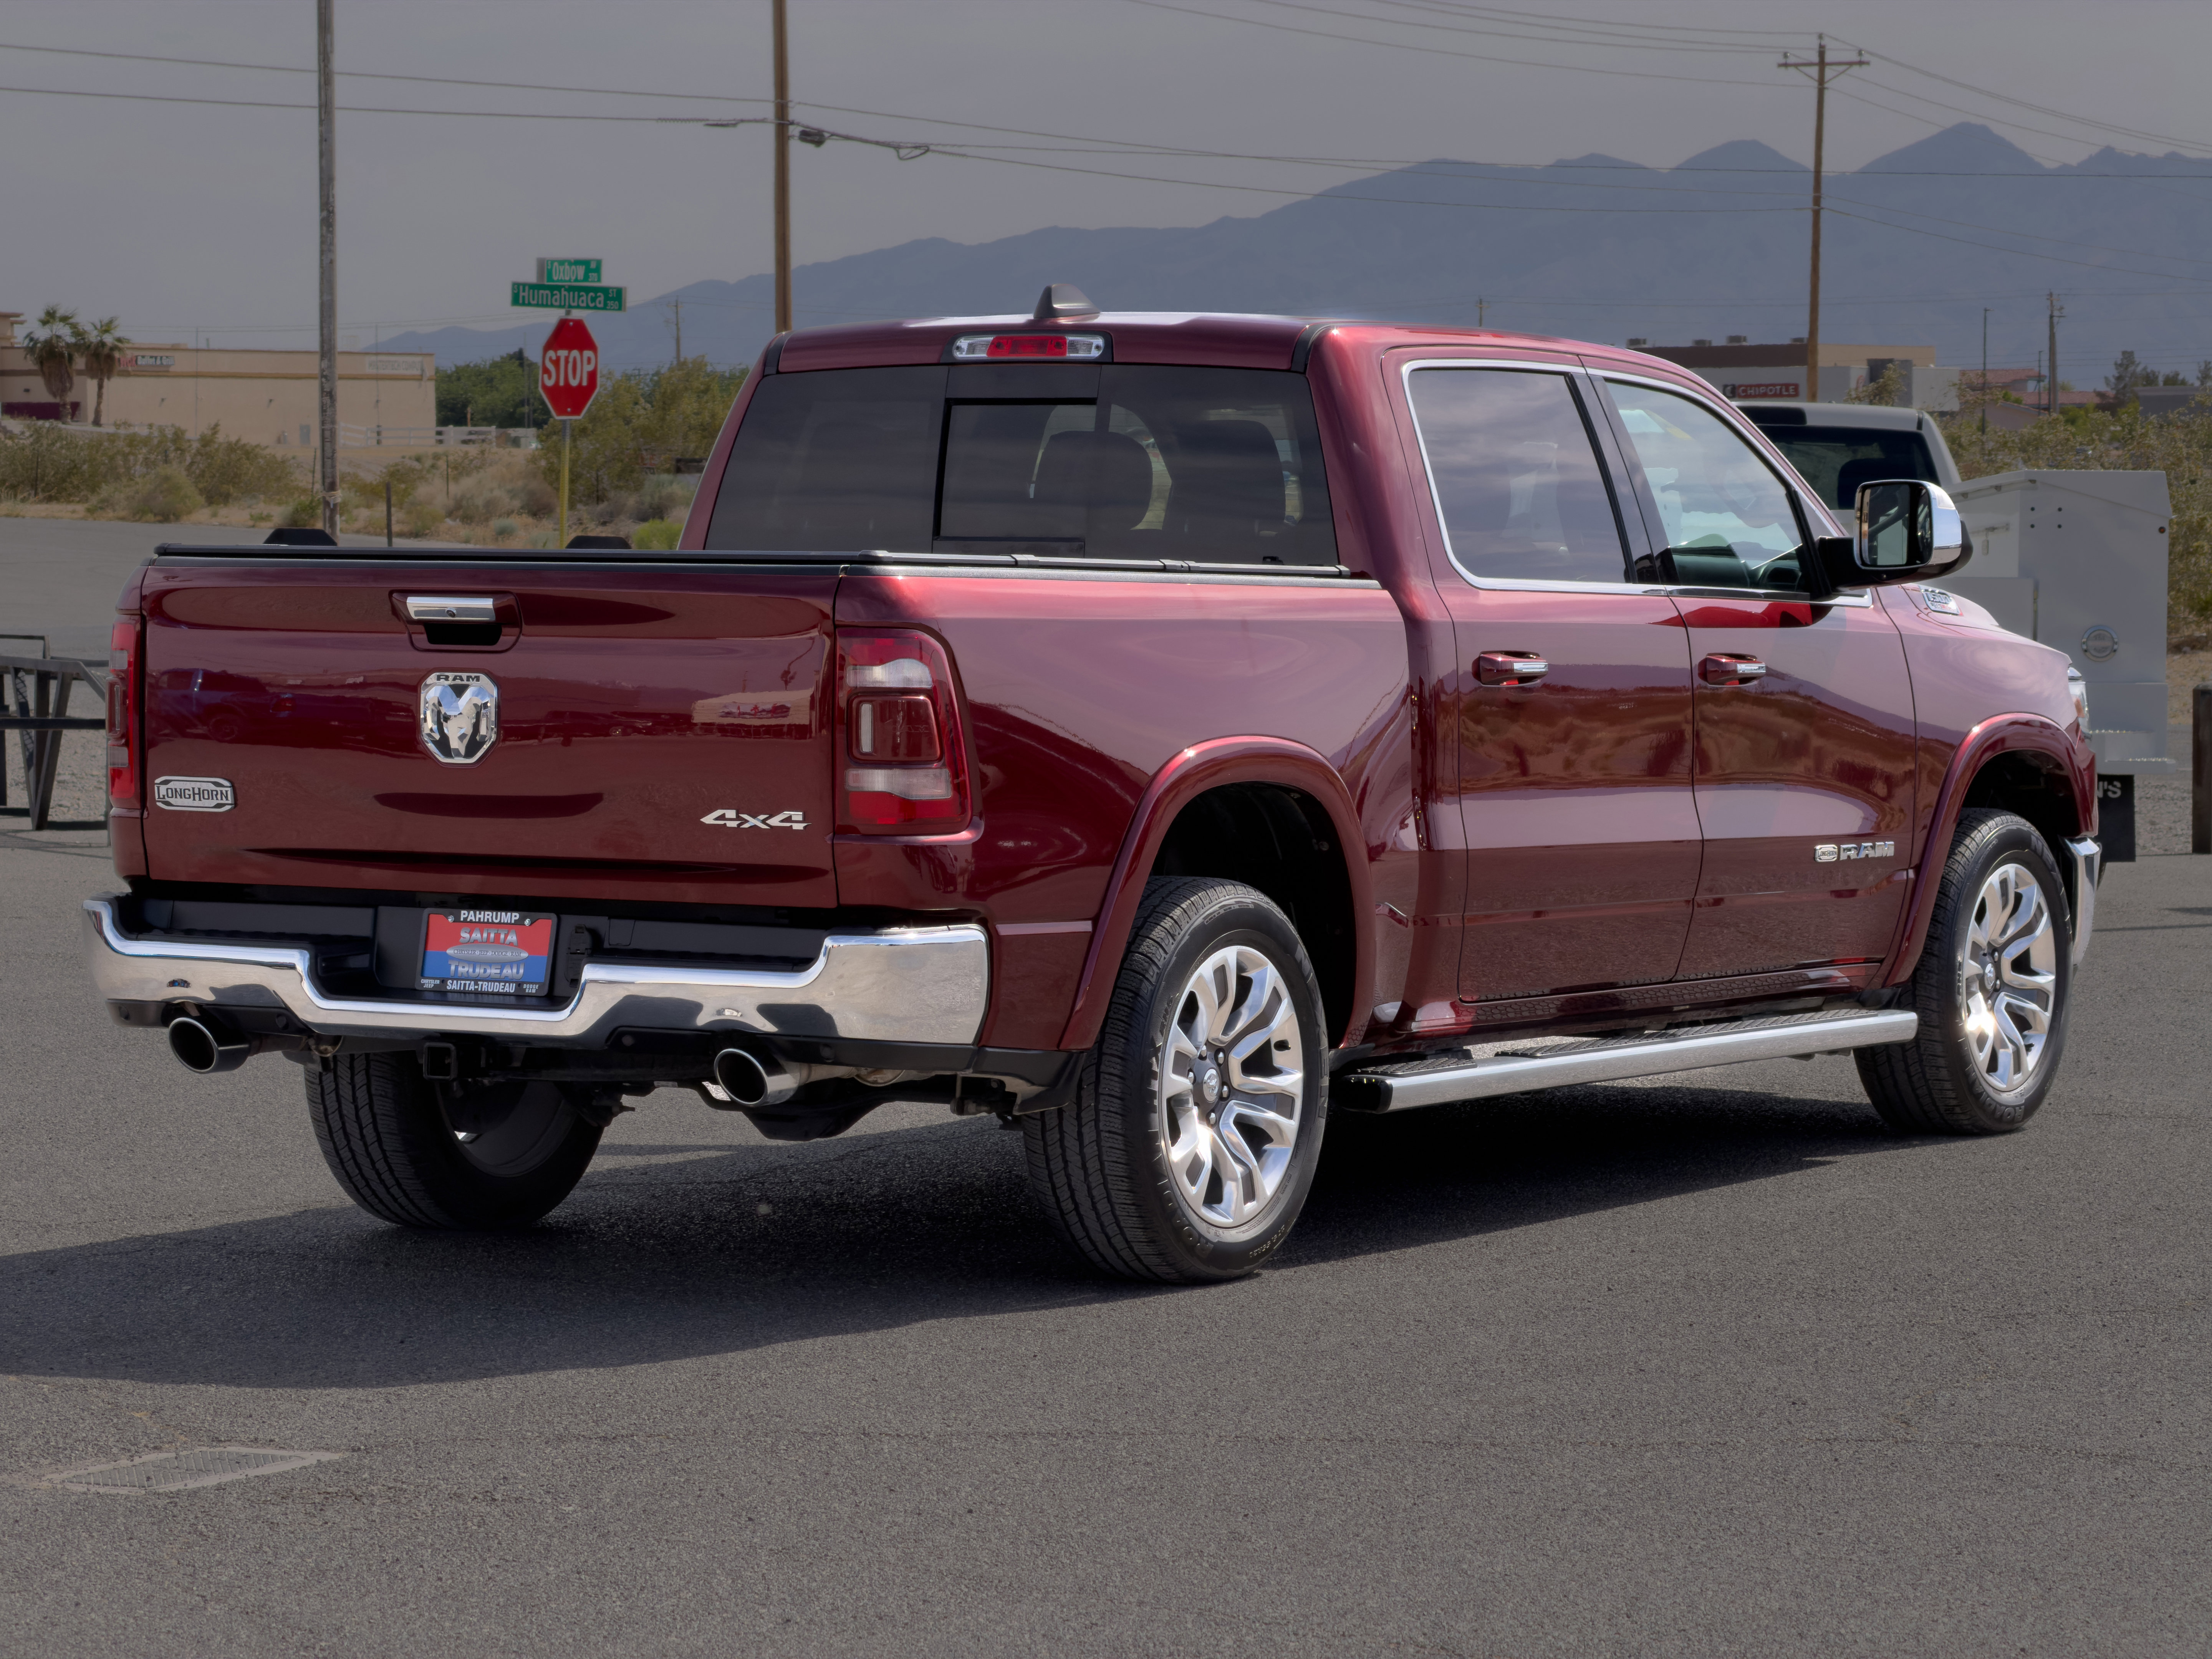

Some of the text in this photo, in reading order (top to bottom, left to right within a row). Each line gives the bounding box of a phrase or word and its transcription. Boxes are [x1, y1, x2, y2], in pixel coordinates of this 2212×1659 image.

[548, 261, 551, 269] S
[552, 262, 585, 280] Oxbow
[513, 285, 617, 308] S Humahuaca ST
[606, 301, 619, 309] 350
[543, 349, 595, 387] STOP
[1738, 386, 1796, 396] CHIPOTLE
[700, 809, 812, 830] 4x4
[1839, 841, 1894, 861] RAM
[460, 911, 520, 923] PAHRUMP
[459, 927, 518, 946] SAITTA
[448, 959, 525, 980] TRUDEAU
[447, 980, 516, 993] SAITTA-TRUDEAU
